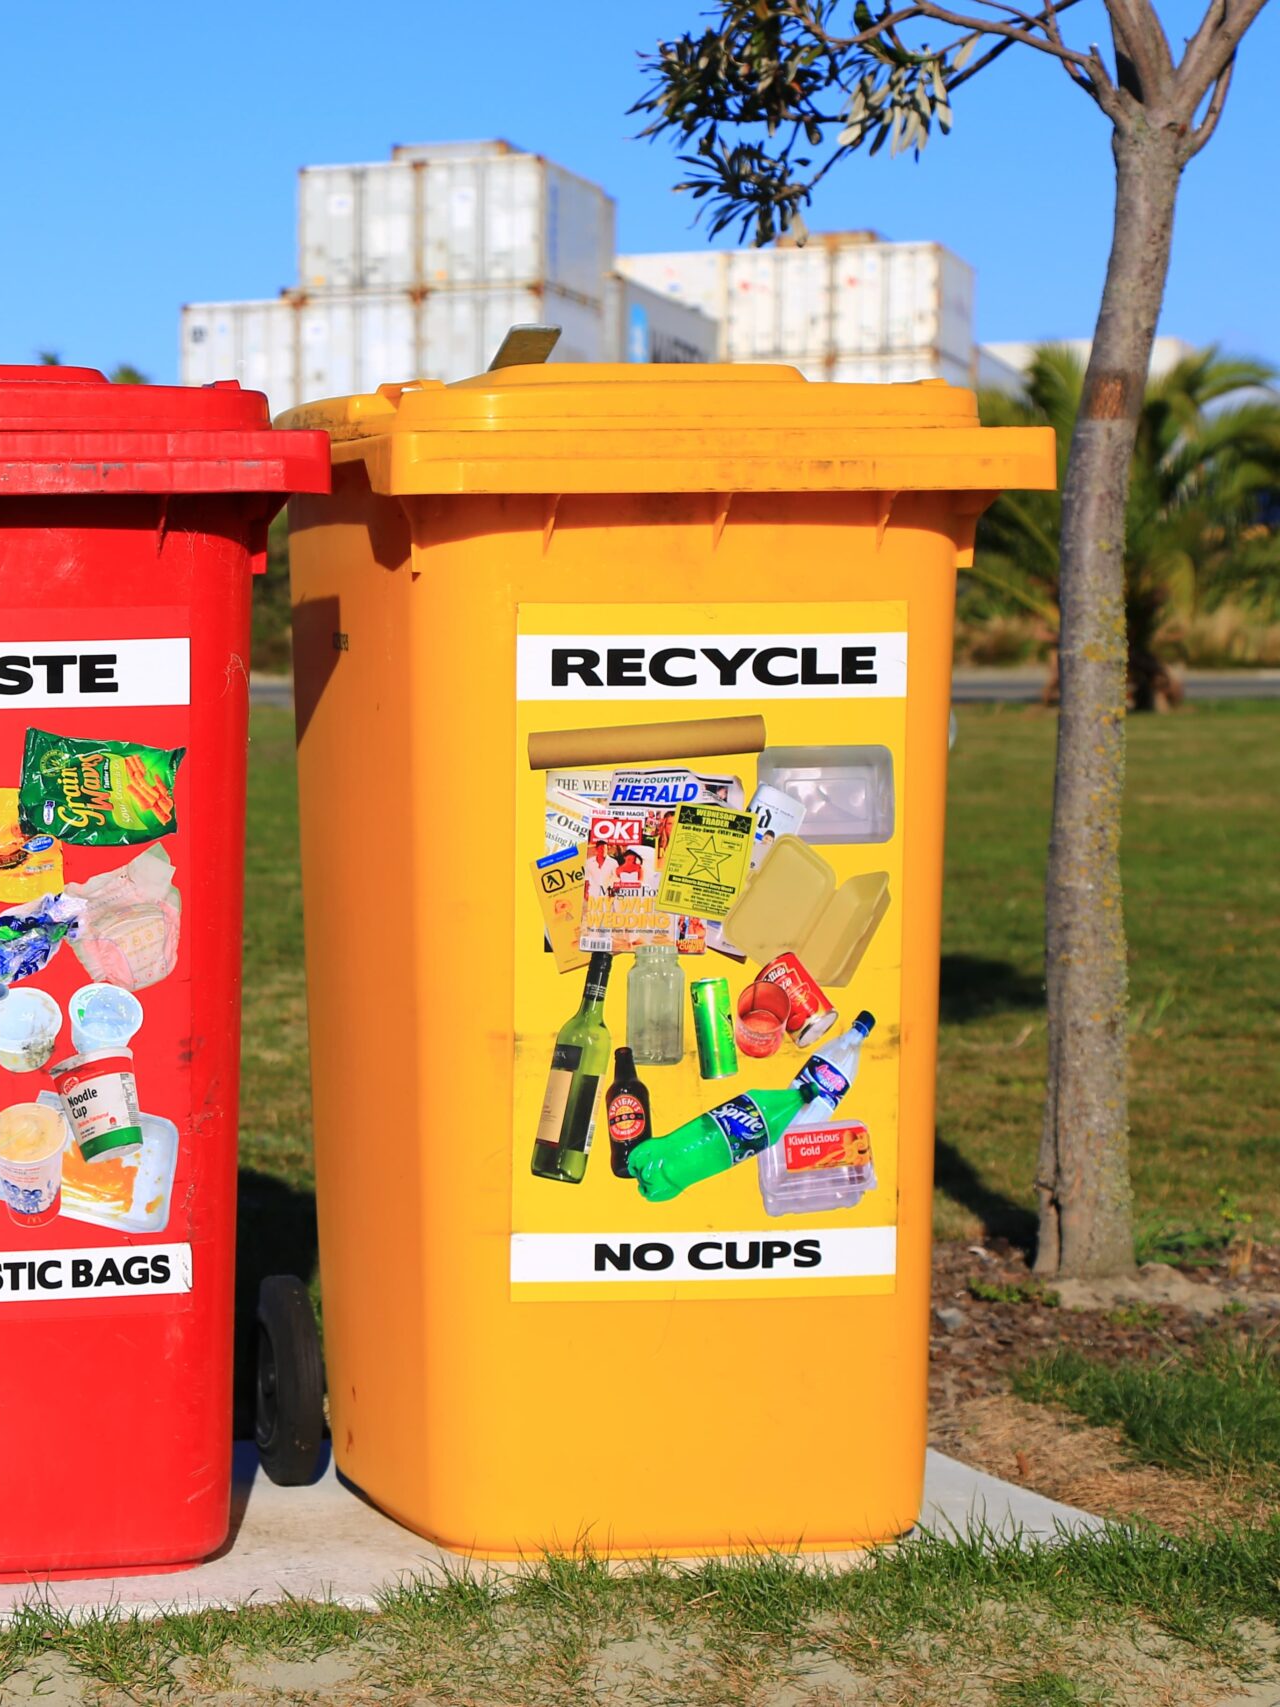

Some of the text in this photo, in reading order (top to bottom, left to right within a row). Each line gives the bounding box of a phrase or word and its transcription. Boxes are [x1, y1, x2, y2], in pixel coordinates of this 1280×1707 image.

[551, 646, 878, 687] RECYCLE
[78, 753, 114, 811] Waves
[555, 778, 611, 792] THE WEE
[643, 776, 689, 784] COUNTRY
[57, 767, 106, 828] Grain
[611, 783, 699, 803] HERALD
[696, 808, 737, 822] WEDNESDAY
[702, 817, 730, 828] TRADER
[557, 814, 589, 837] Otag
[593, 820, 640, 840] OK!
[588, 896, 657, 914] MY WHI
[586, 911, 671, 930] WEDDING
[67, 1088, 98, 1108] Noodle
[72, 1105, 88, 1120] Cup
[711, 1102, 764, 1133] Sprite
[789, 1133, 840, 1146] KiwiLicious
[800, 1145, 821, 1157] Gold
[594, 1238, 822, 1272] NO CUPS
[71, 1255, 171, 1287] BAGS
